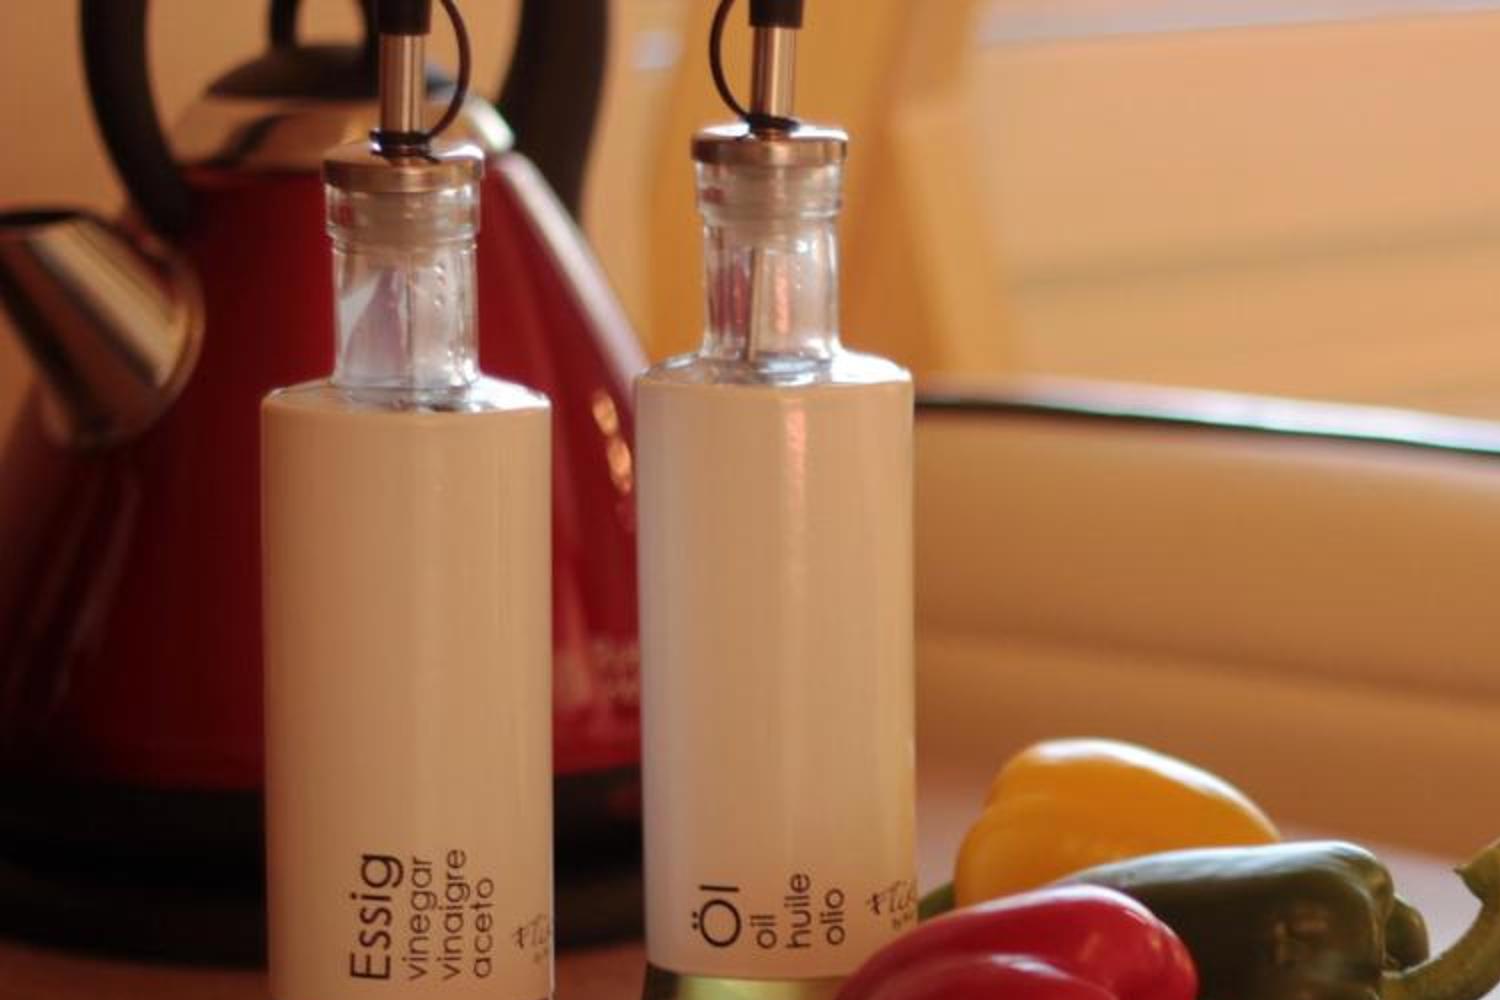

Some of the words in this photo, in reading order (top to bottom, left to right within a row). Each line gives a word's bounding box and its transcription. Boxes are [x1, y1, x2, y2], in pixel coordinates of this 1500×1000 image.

[349, 853, 404, 981] Essig
[402, 856, 438, 980] vinegar
[436, 849, 471, 980] vinaigre
[470, 878, 495, 978] aceto
[692, 884, 741, 947] Öl
[750, 914, 777, 949] oil
[784, 873, 811, 949] huile
[820, 888, 845, 945] olio
